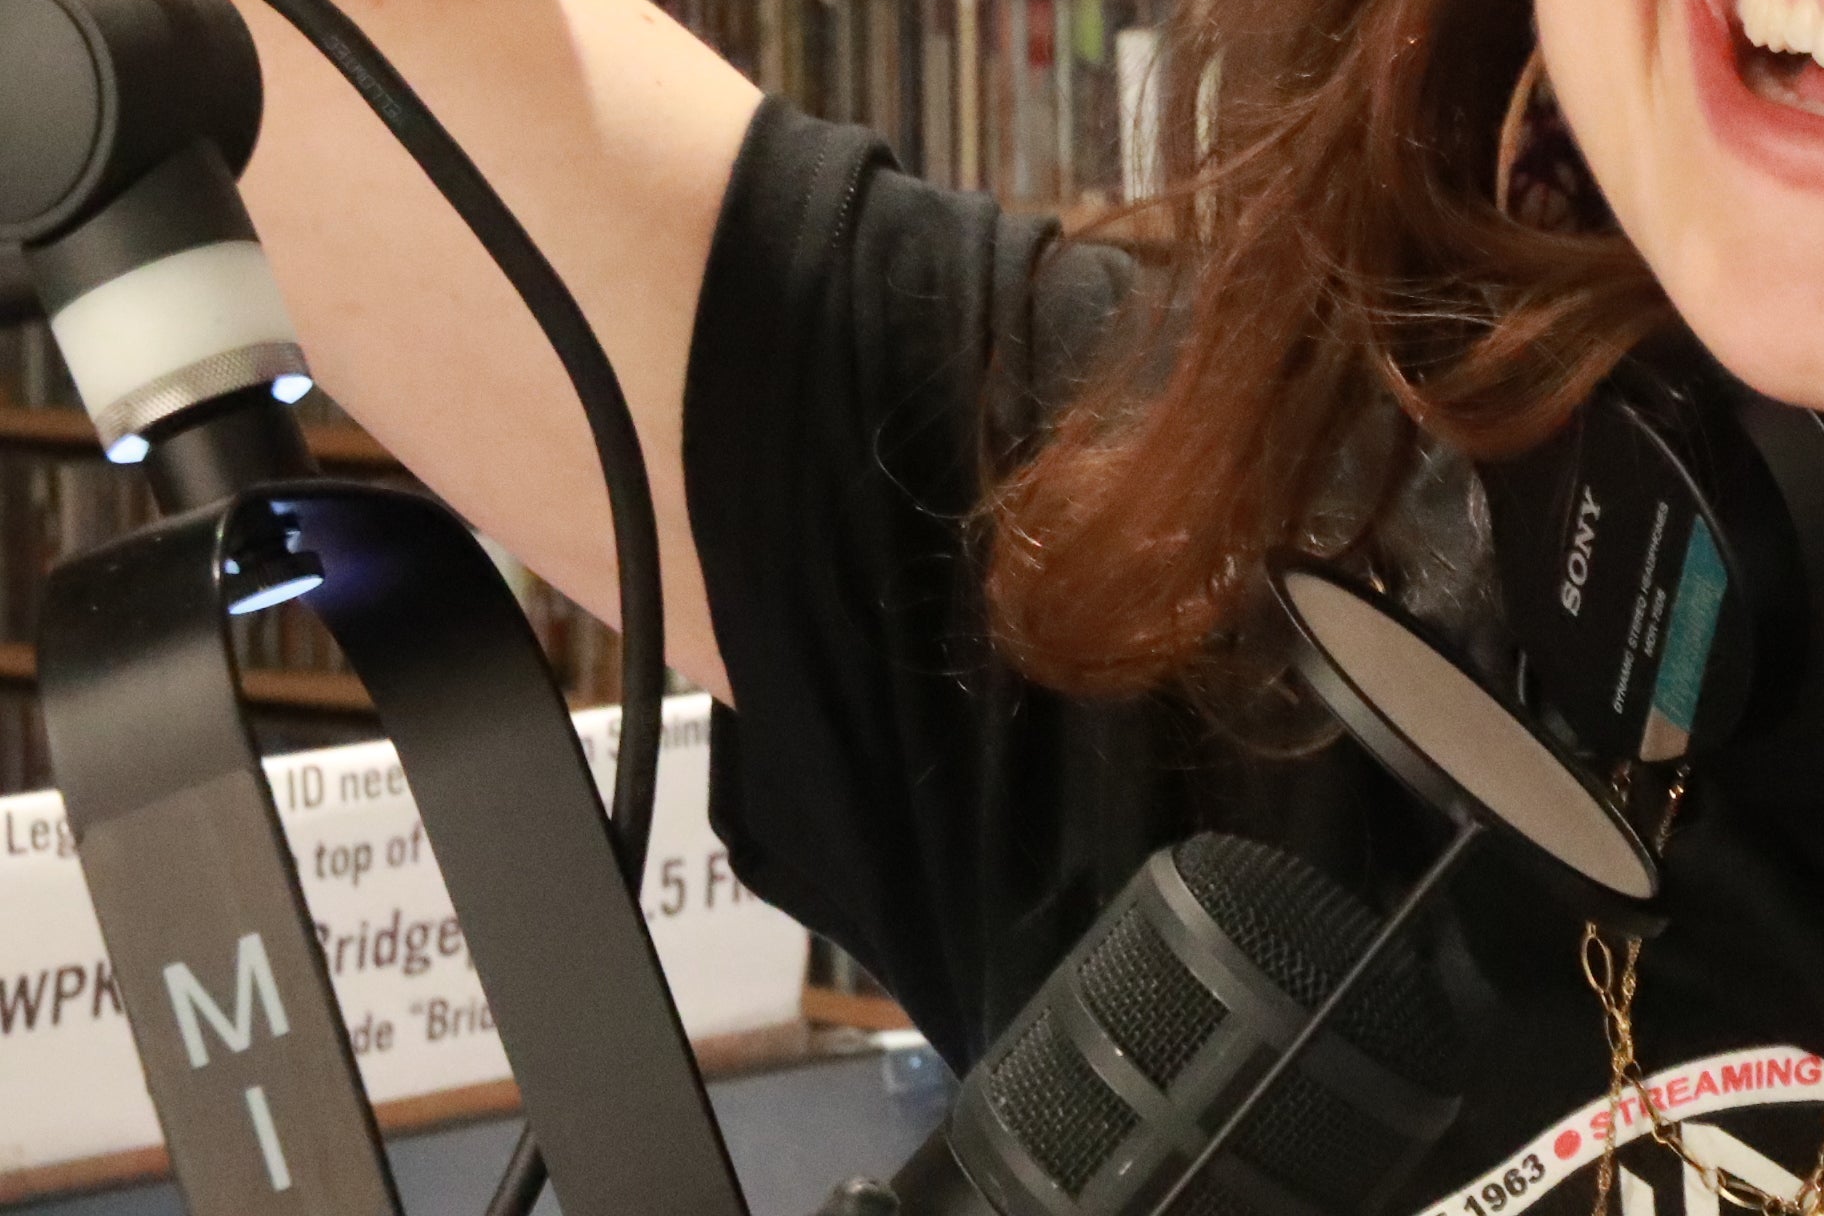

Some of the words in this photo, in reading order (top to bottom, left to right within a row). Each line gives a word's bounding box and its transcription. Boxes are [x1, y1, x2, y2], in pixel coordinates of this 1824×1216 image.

[1561, 485, 1601, 617] SONY
[1613, 650, 1636, 715] DYNAMIC
[1628, 594, 1648, 650] STEREO
[1641, 500, 1669, 595] HEADPHONES
[6, 810, 77, 858] Leg
[287, 763, 325, 812] ID
[340, 763, 405, 803] nee
[314, 839, 373, 889] top
[386, 819, 424, 867] of
[0, 961, 124, 1035] WPK
[316, 908, 475, 976] ridge
[1463, 1153, 1547, 1216] 1963
[1589, 1052, 1823, 1140] STREAMING
